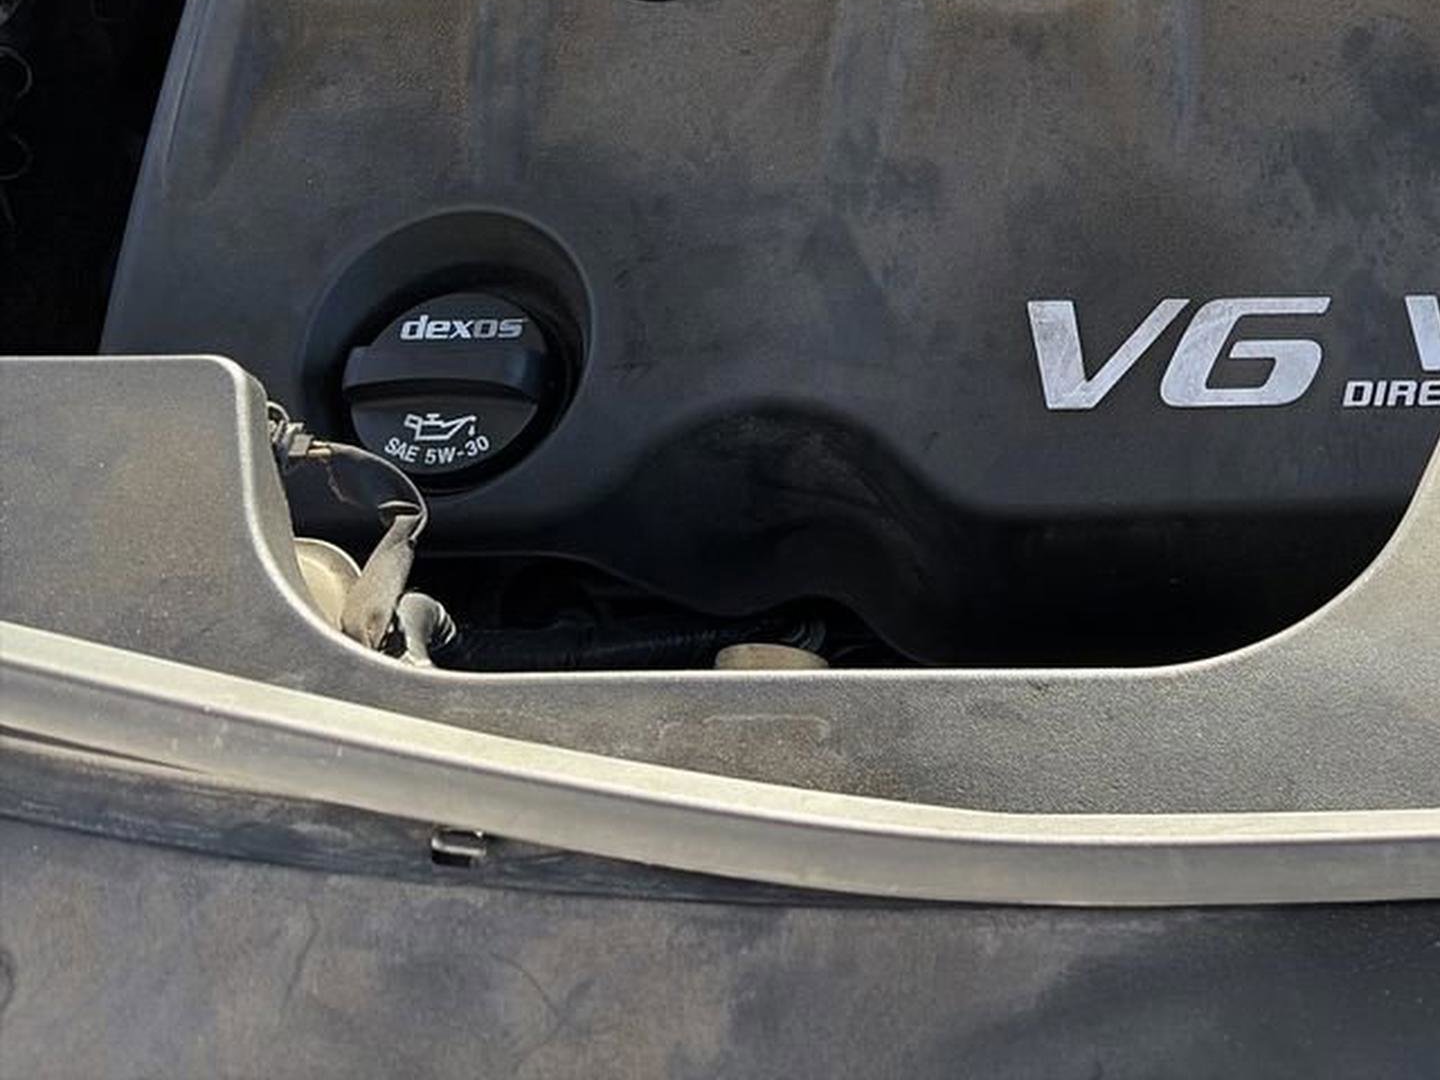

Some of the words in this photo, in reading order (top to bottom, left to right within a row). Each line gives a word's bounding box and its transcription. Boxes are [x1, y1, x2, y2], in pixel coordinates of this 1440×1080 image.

[400, 315, 523, 341] dexos
[1027, 296, 1332, 410] V6
[384, 437, 419, 463] SAE
[424, 435, 490, 464] 5W-30
